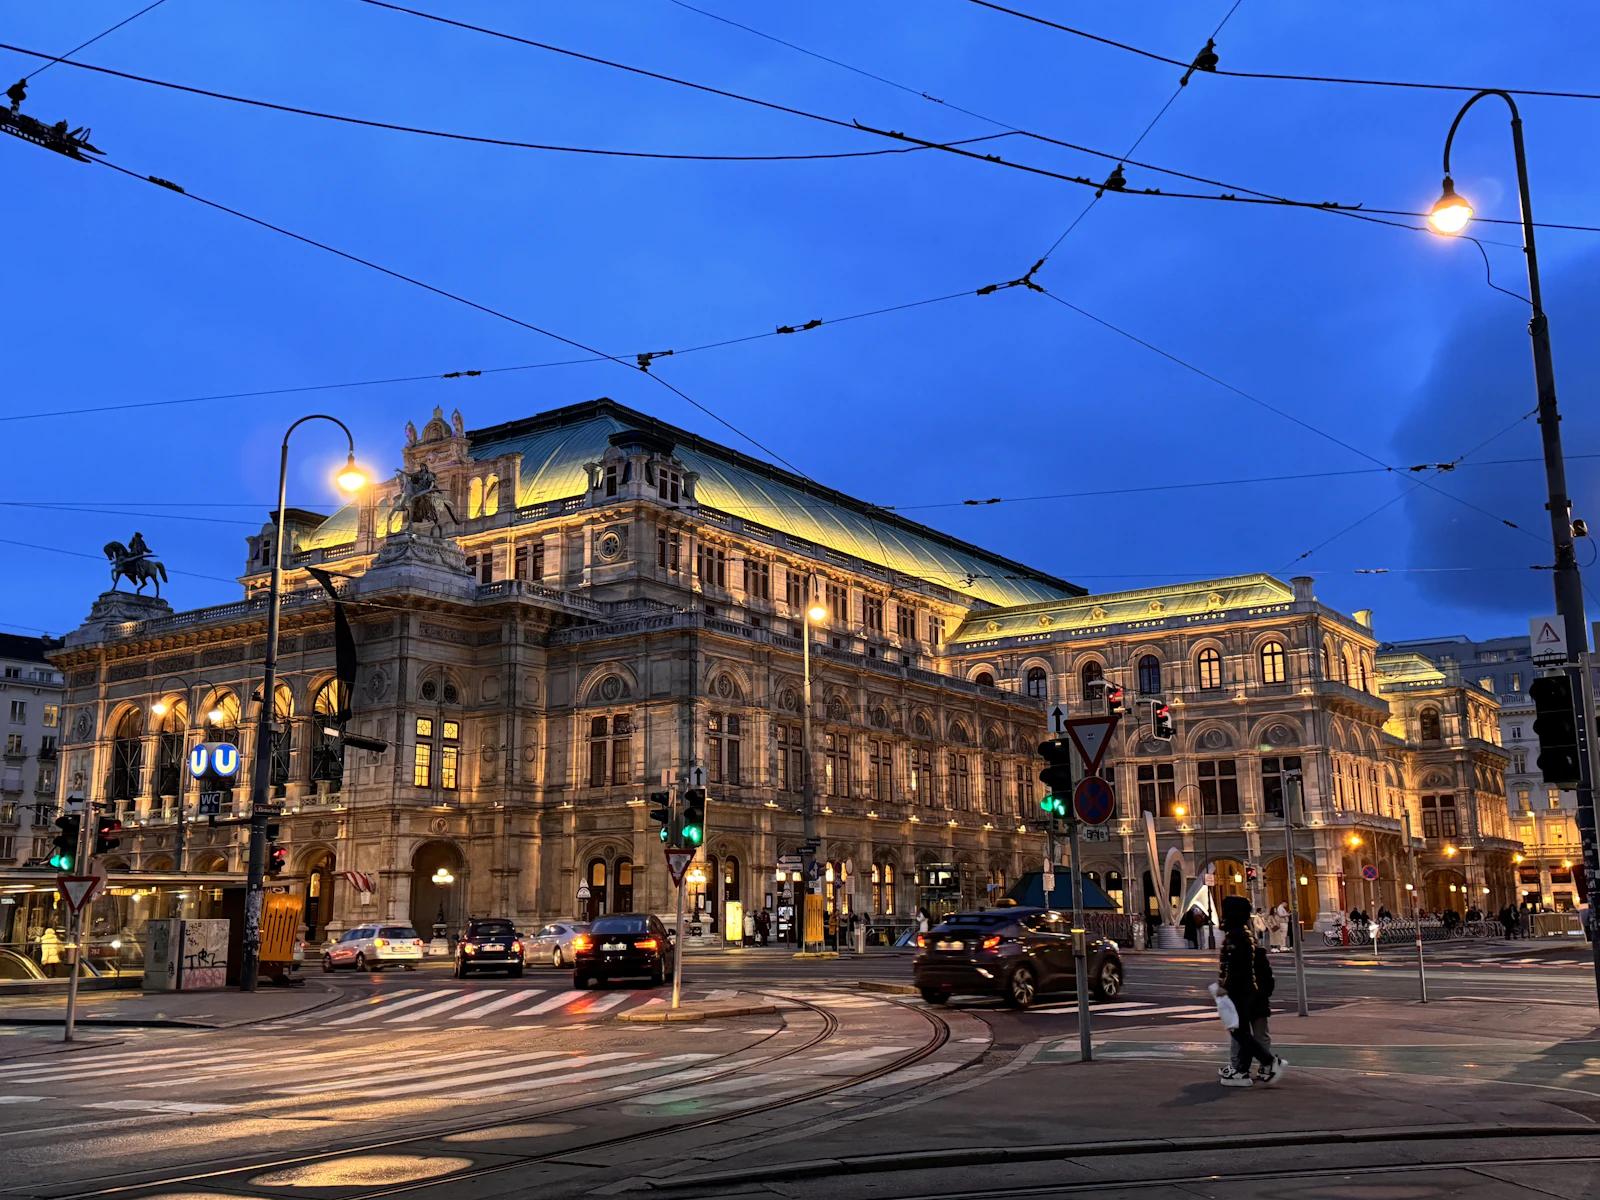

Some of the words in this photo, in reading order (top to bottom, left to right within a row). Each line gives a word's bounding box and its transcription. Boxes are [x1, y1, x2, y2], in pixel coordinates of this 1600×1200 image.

[191, 749, 207, 775] U
[215, 749, 237, 774] U
[201, 794, 219, 804] WC
